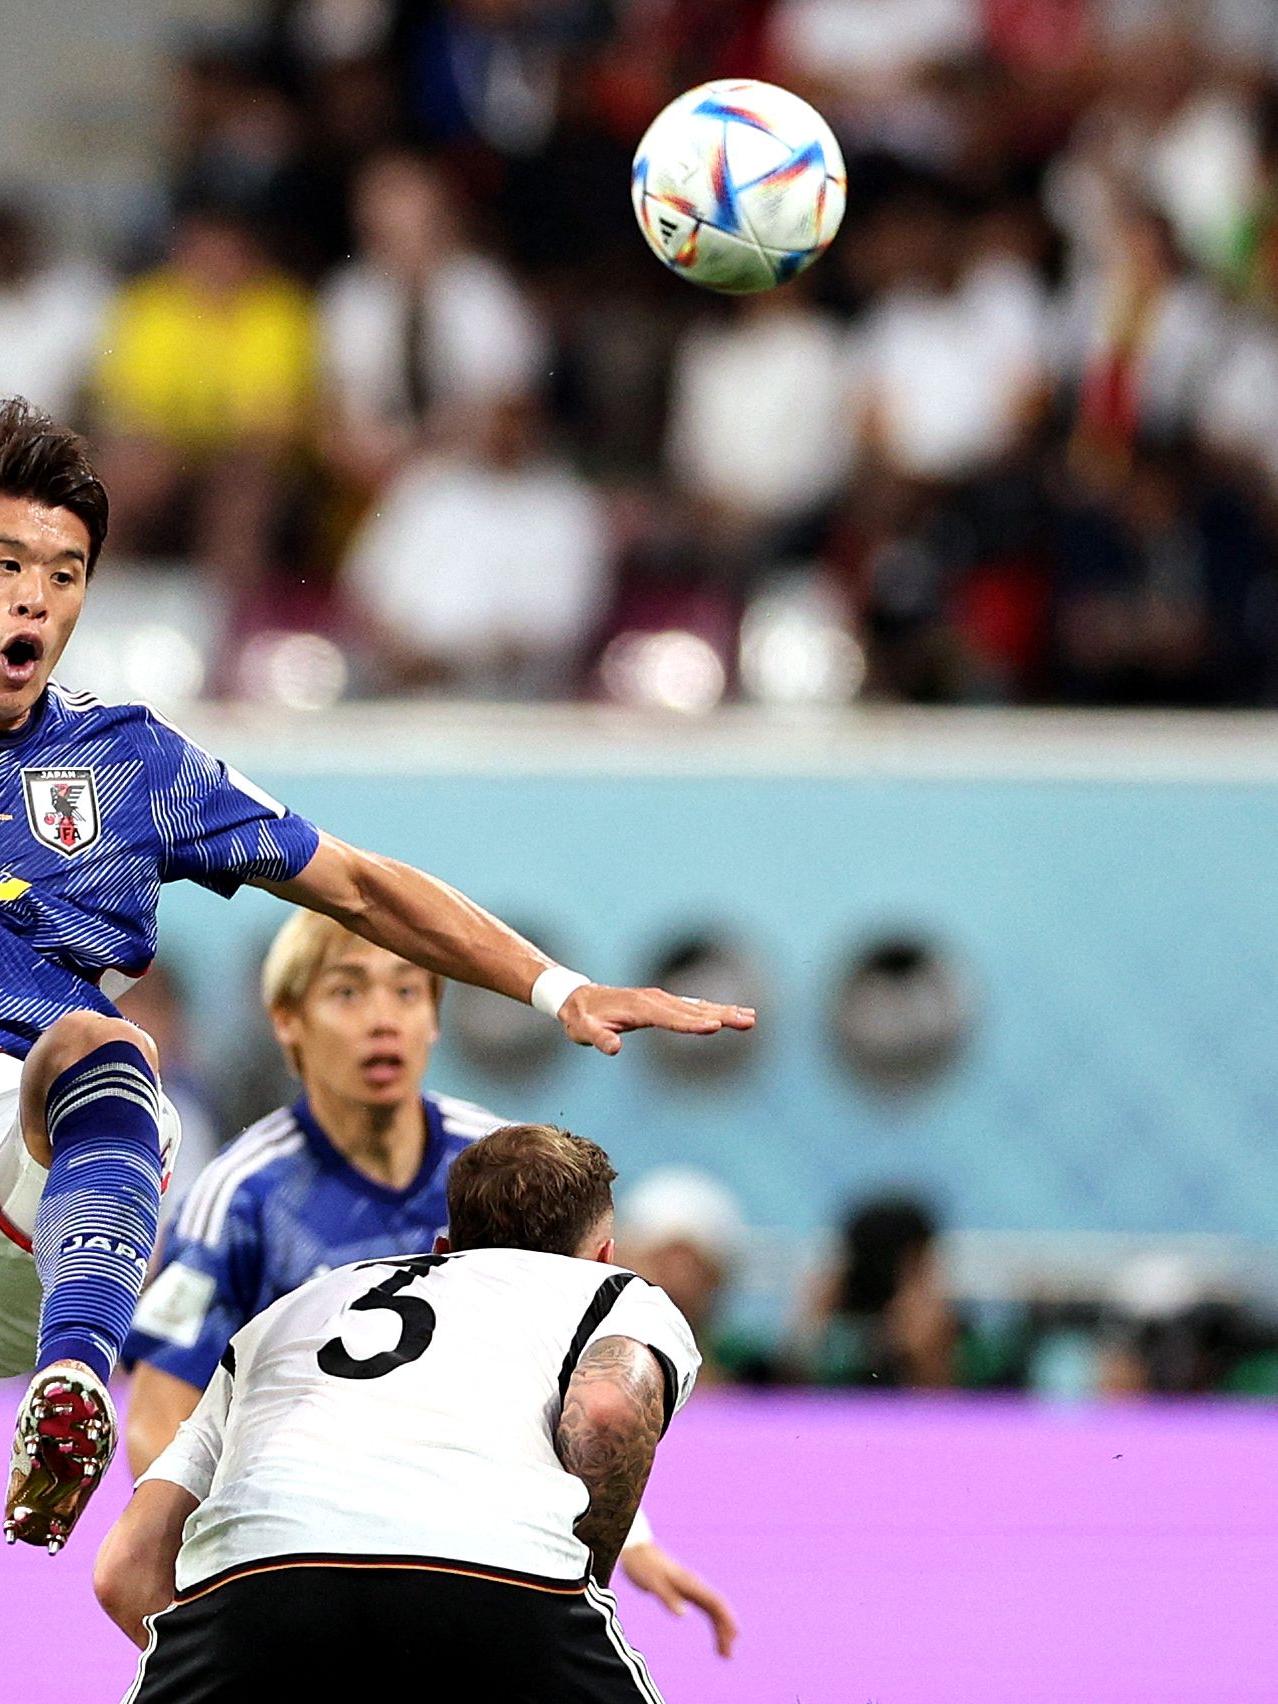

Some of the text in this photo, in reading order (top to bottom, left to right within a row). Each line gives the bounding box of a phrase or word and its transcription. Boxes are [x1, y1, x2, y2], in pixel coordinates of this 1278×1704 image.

[40, 770, 76, 779] JAPAN
[53, 827, 82, 841] JFA
[316, 1254, 452, 1380] 3
